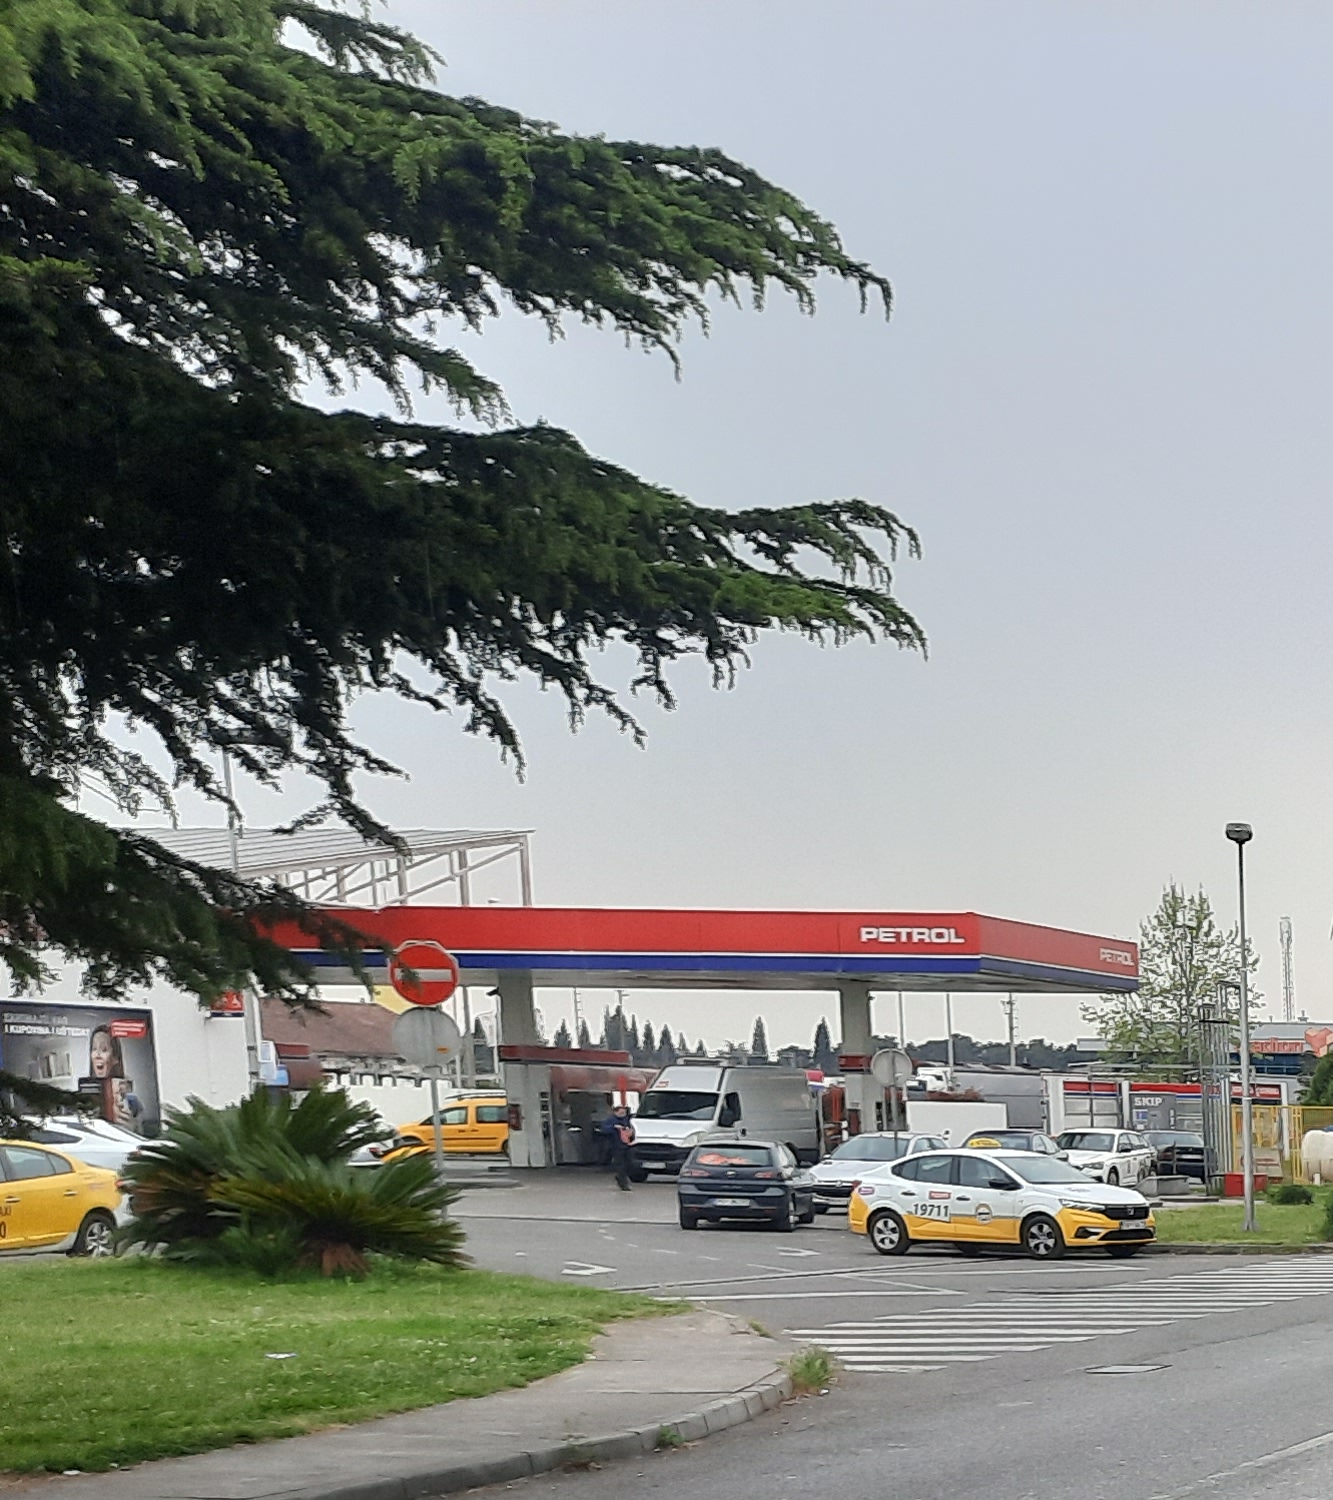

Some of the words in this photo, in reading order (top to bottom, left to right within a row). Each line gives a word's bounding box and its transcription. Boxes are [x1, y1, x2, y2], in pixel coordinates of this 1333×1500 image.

[860, 926, 966, 945] PETROL
[1099, 947, 1135, 967] PETROL
[1134, 1097, 1163, 1107] SKIP
[912, 1202, 950, 1218] 19711
